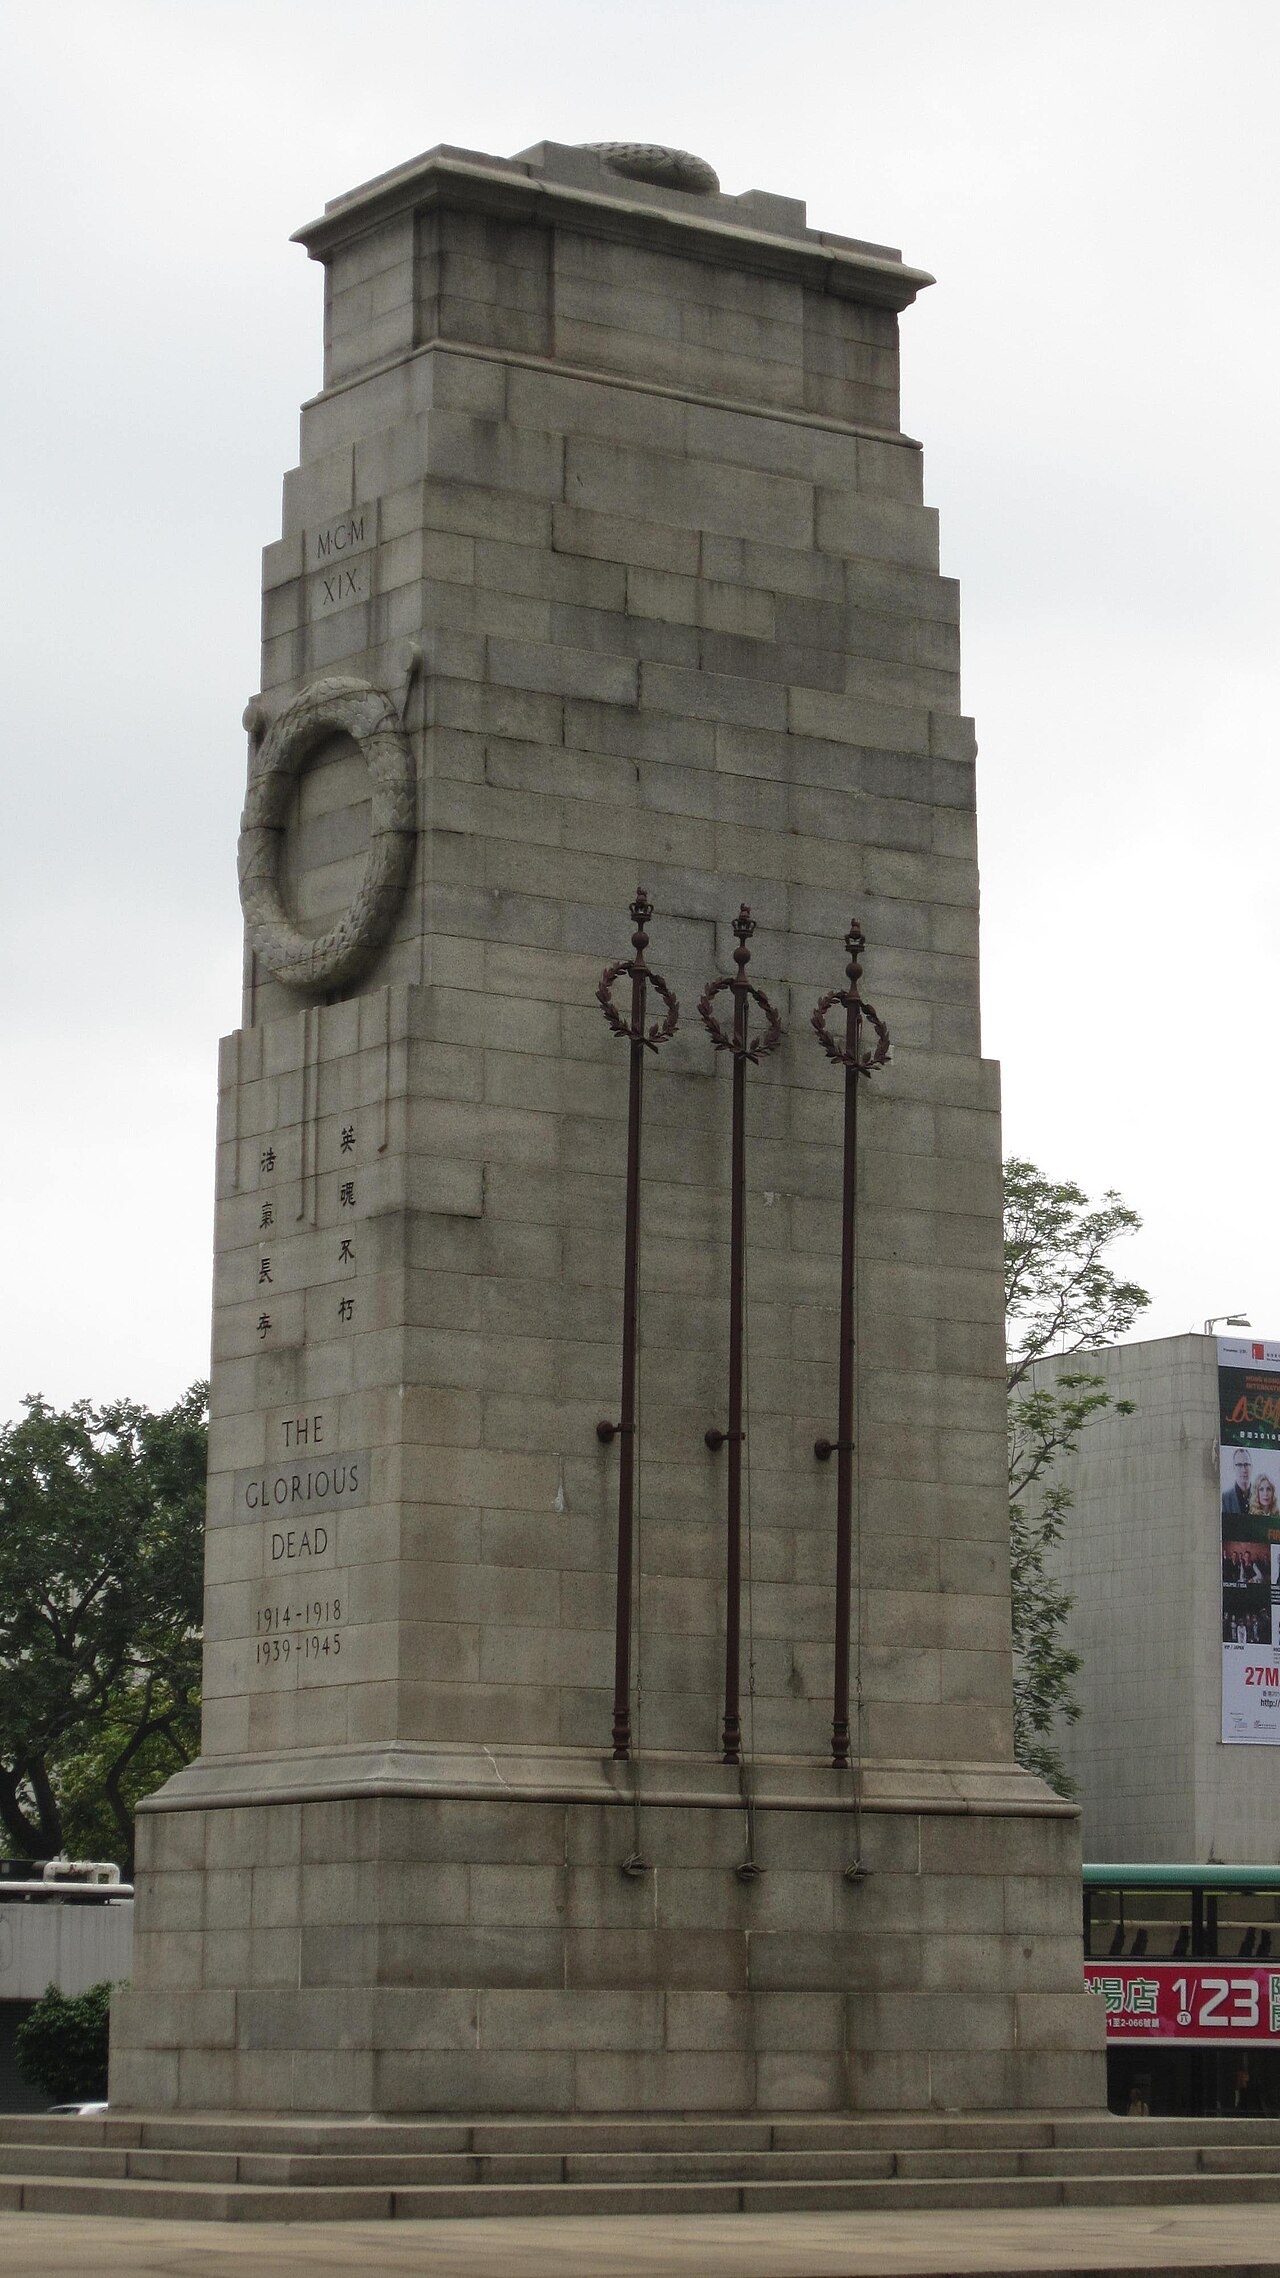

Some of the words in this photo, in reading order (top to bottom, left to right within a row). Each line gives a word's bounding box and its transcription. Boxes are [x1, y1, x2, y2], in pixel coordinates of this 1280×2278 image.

[282, 1415, 324, 1448] THE
[245, 1465, 359, 1509] GLORIOUS
[271, 1527, 328, 1561] DEAD
[256, 1599, 342, 1633] 1914-1918
[256, 1633, 342, 1666] 1939-1945
[1260, 1699, 1280, 1709] http://
[1085, 1977, 1160, 2014] 場店
[1171, 1978, 1260, 2027] 1/23
